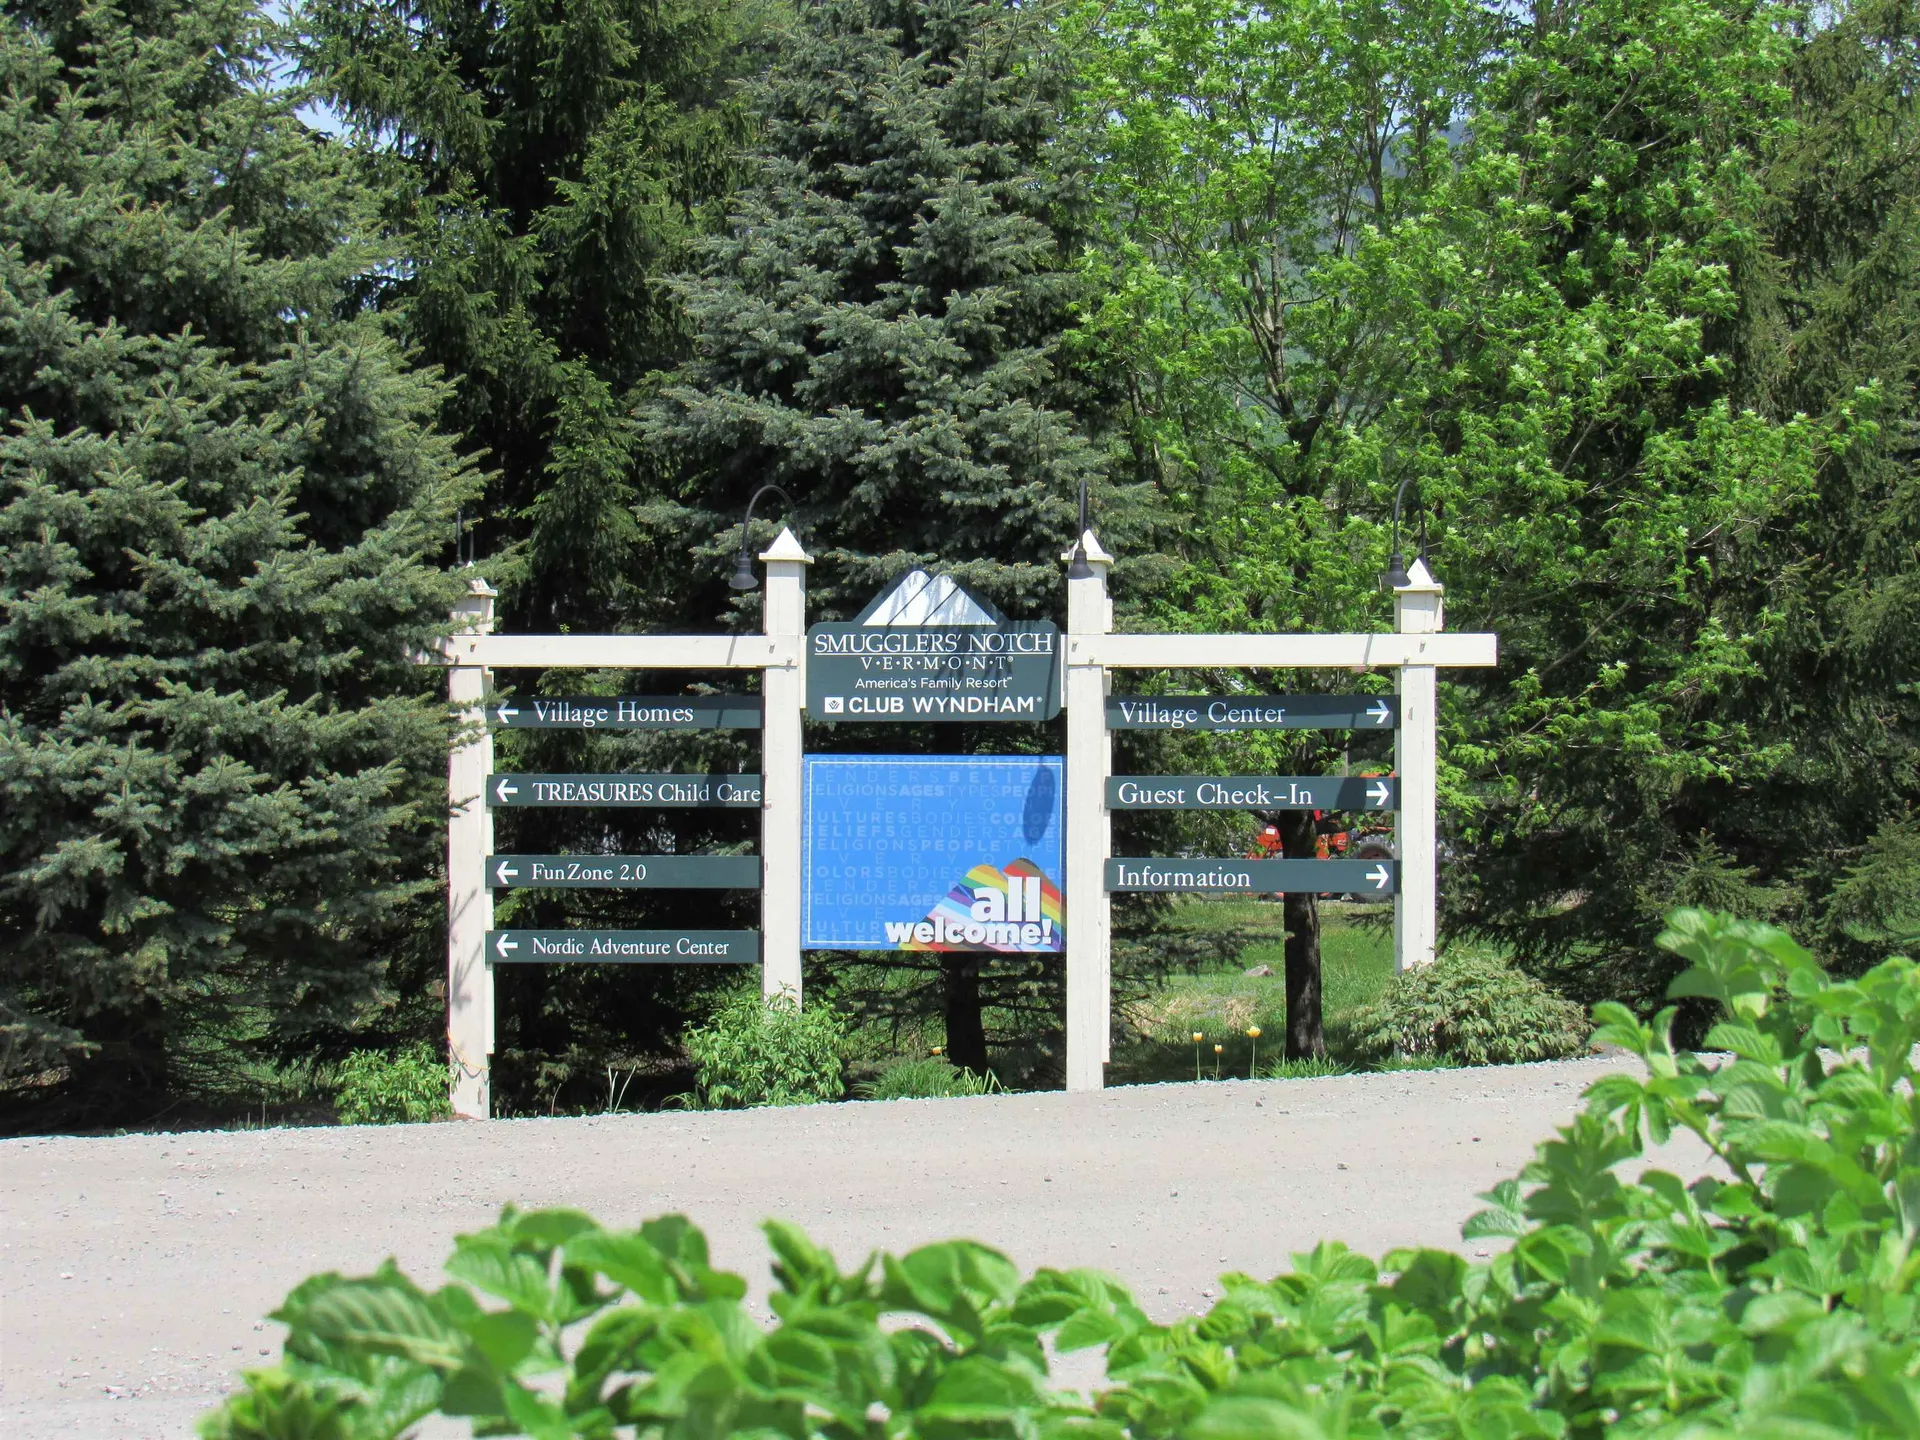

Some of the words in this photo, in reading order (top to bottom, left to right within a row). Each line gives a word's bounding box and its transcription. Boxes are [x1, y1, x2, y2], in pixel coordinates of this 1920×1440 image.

[815, 633, 962, 653] SMUGGLERS'
[967, 633, 1053, 652] NOTCH
[855, 677, 917, 689] America's
[920, 677, 962, 691] Family
[532, 701, 608, 727] Village
[616, 701, 694, 722] Homes
[849, 696, 904, 713] CLUB
[1118, 702, 1198, 729] Village
[1207, 701, 1286, 723] Center
[532, 782, 653, 801] TREASURES
[658, 782, 710, 802] Child
[716, 783, 761, 802] Care
[1118, 782, 1186, 804] Guest
[619, 863, 647, 880] 2.0
[1118, 865, 1251, 887] Information
[971, 876, 1041, 922] all
[884, 916, 1052, 944] welcome!
[532, 937, 584, 955] Nordic
[590, 937, 671, 955] Adventure
[676, 937, 730, 955] Center
